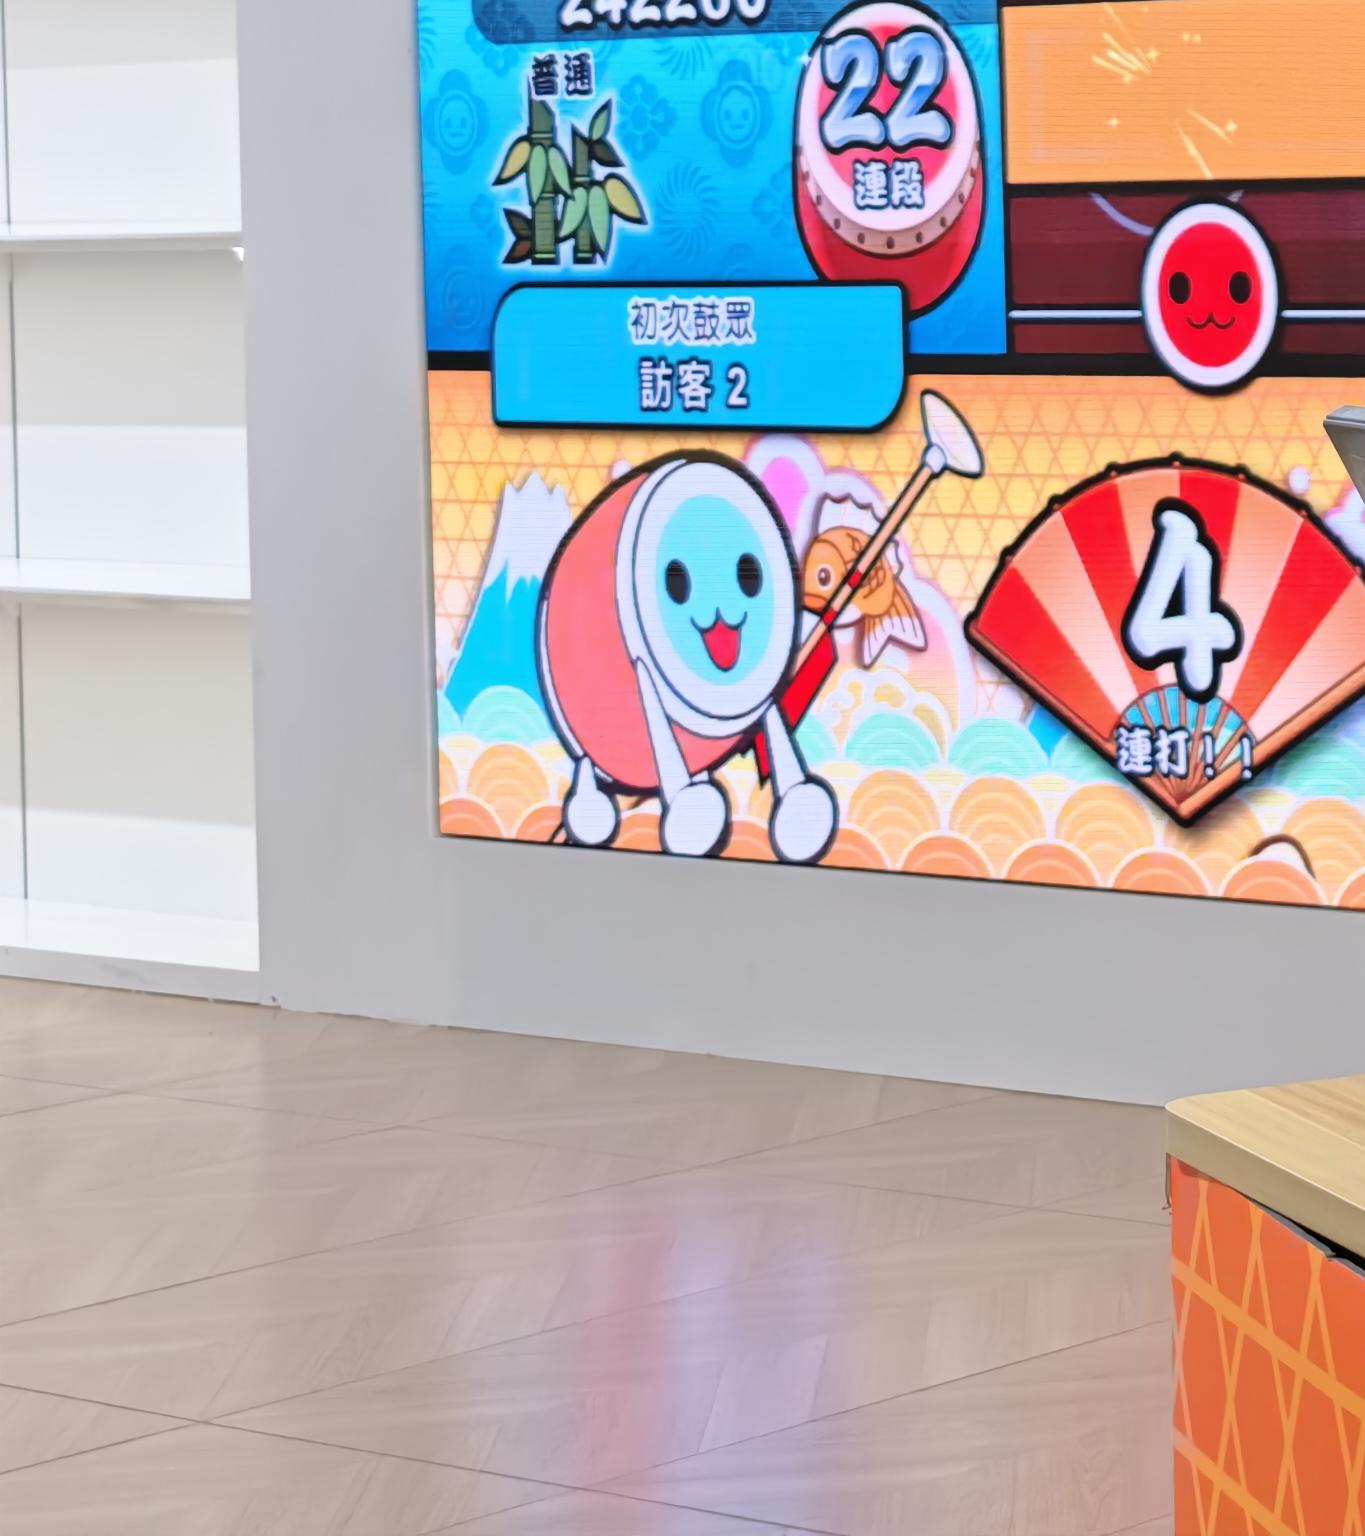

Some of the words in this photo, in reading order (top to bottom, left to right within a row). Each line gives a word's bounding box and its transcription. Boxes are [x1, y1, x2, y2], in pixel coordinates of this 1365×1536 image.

[531, 53, 595, 97] 普通
[820, 27, 952, 149] 22
[853, 159, 925, 212] 連段
[639, 358, 713, 411] 訪客
[725, 363, 750, 409] 2
[1123, 499, 1241, 701] 4
